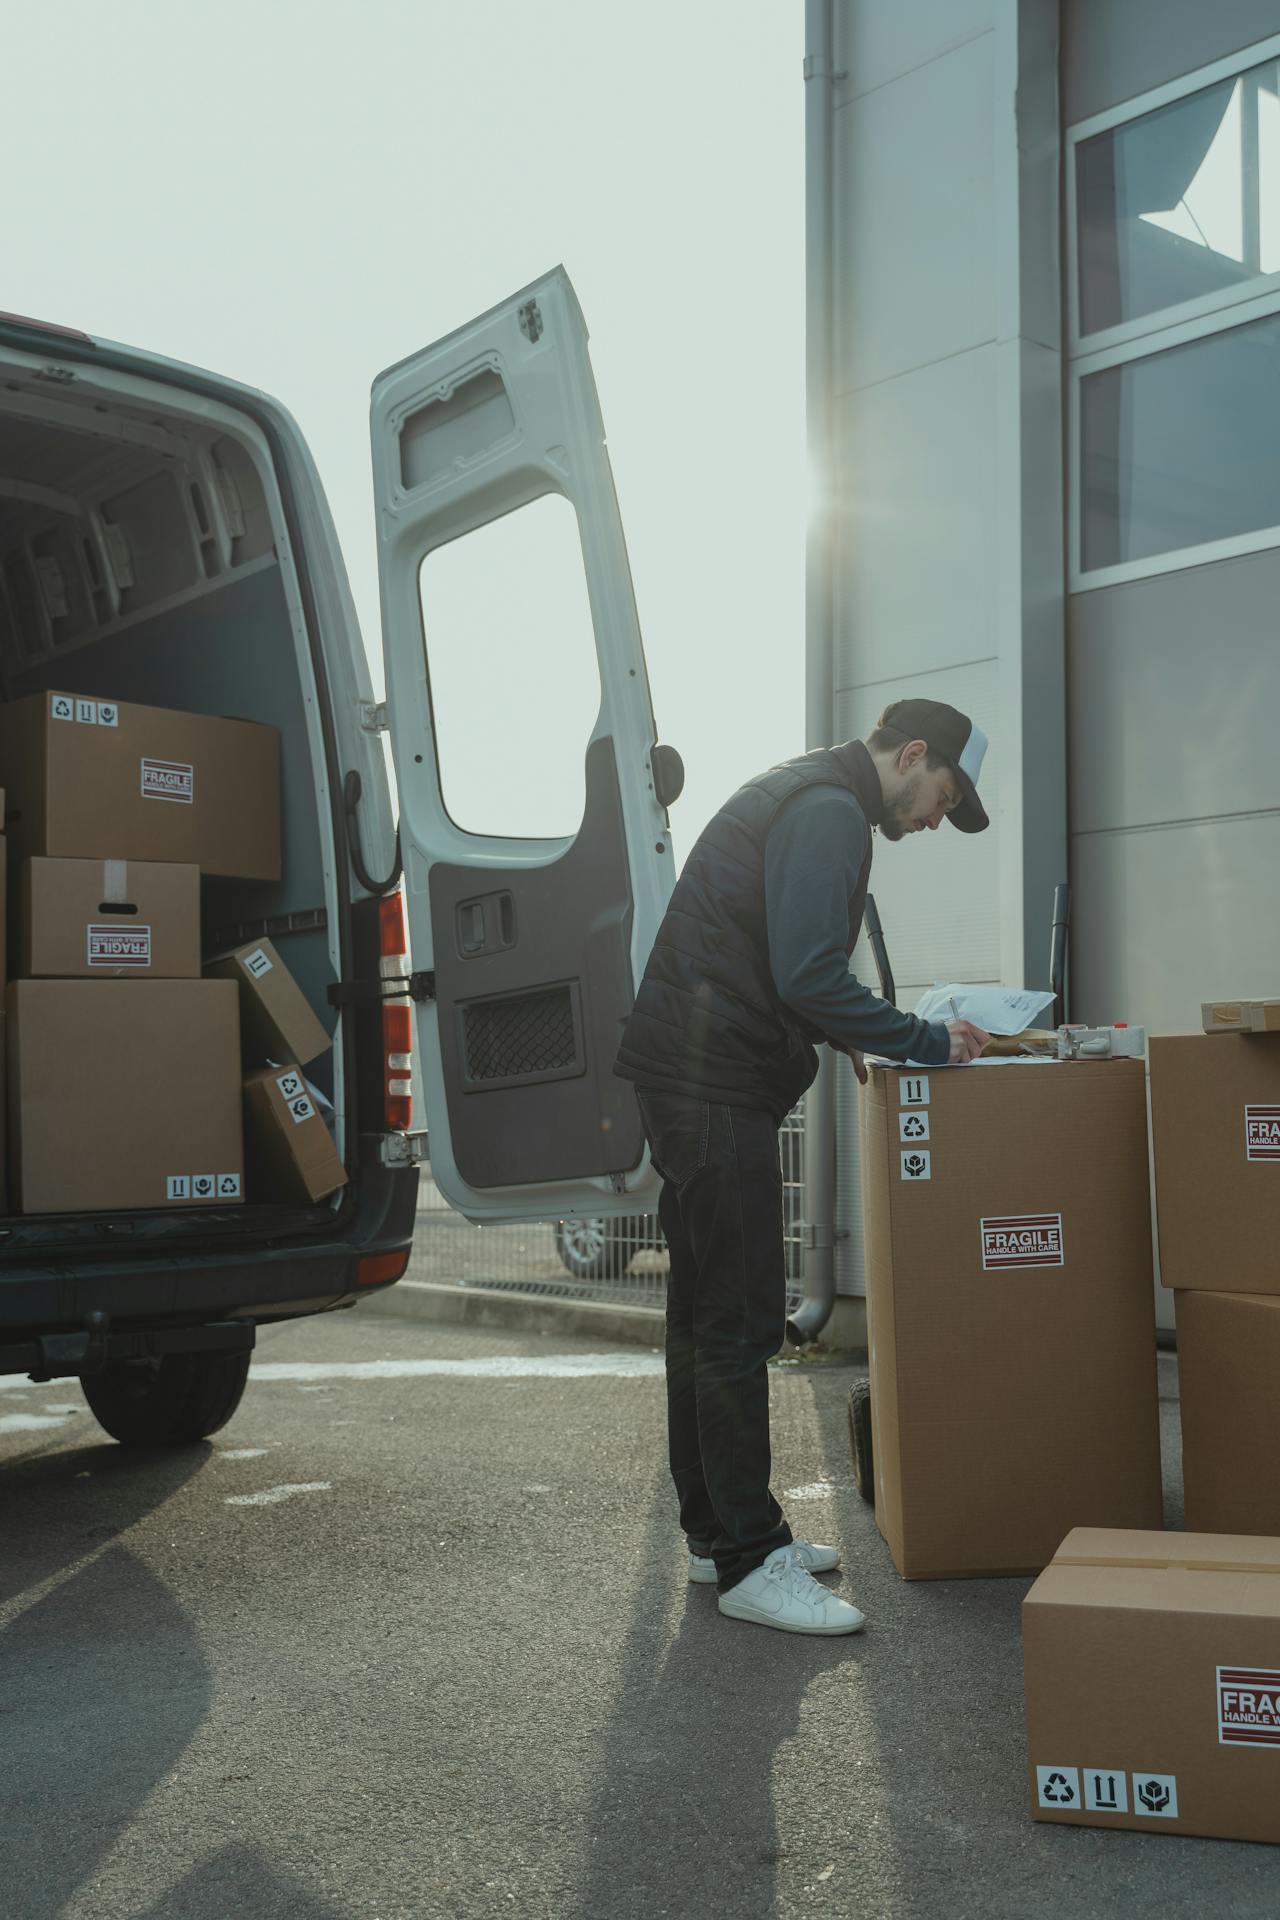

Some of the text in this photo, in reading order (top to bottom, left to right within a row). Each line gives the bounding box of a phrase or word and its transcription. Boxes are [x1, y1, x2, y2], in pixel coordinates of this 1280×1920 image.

[144, 771, 190, 786] FRAGILE
[91, 942, 148, 953] FRAGILE
[1250, 1137, 1279, 1145] HANDLE
[985, 1230, 1059, 1248] FRAGILE
[986, 1243, 1059, 1255] HANDLE WITH CARE
[1223, 1691, 1280, 1714] FRA
[1224, 1711, 1270, 1724] HANDLE
